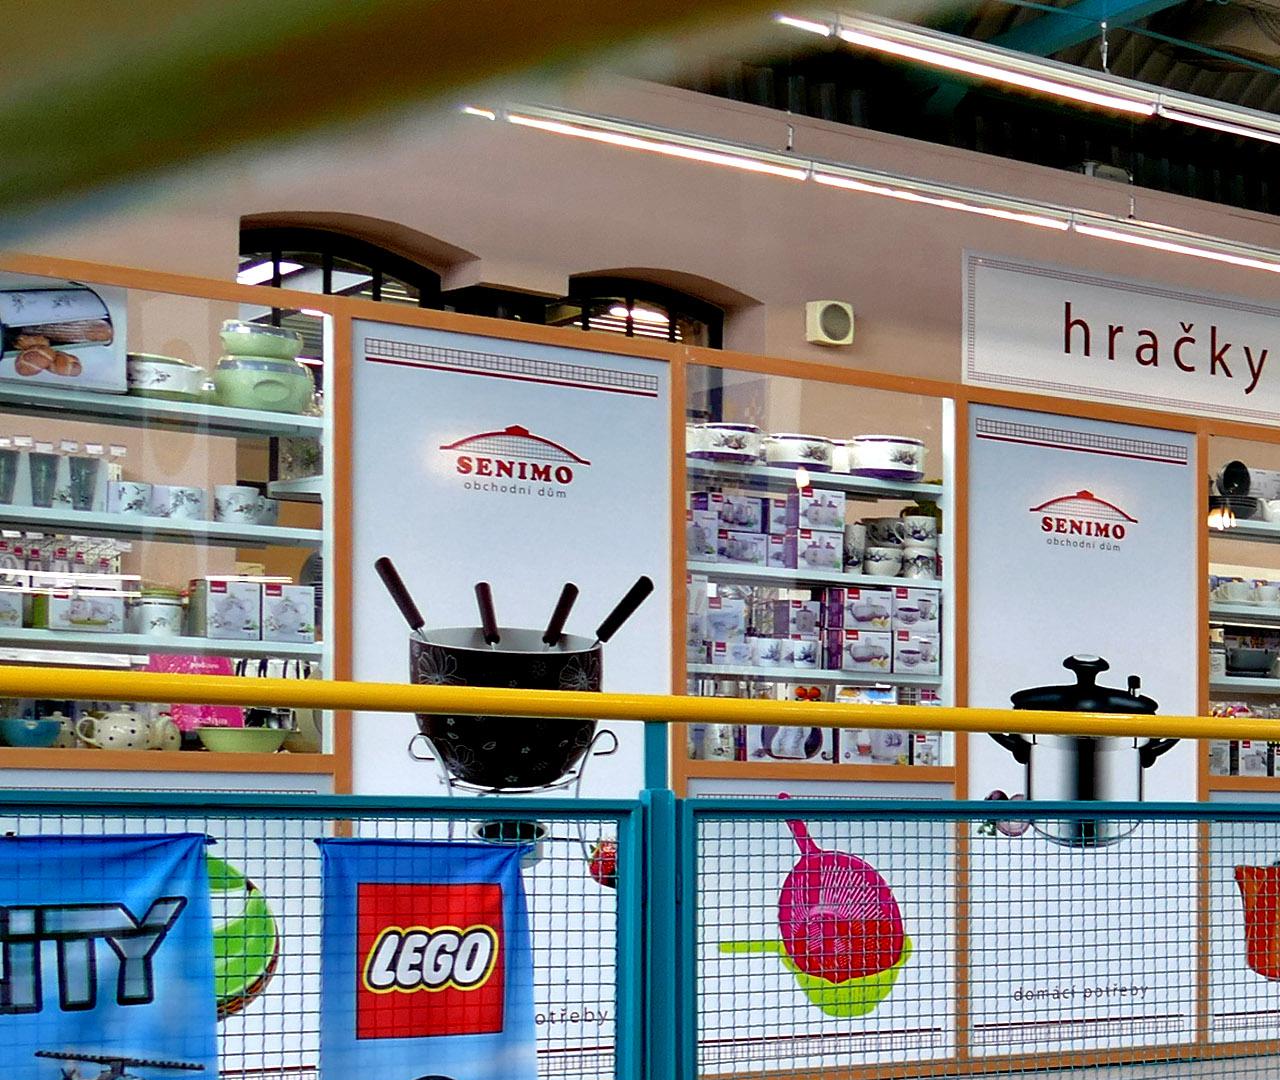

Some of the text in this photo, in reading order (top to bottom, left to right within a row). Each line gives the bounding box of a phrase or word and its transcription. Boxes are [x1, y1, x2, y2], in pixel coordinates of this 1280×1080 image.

[1063, 301, 1269, 395] hračky
[456, 455, 574, 485] SENIMO
[463, 480, 568, 498] obchodní dům
[1041, 515, 1126, 540] SENIMO
[1046, 537, 1121, 551] obchodní dům
[366, 928, 496, 990] LEGO
